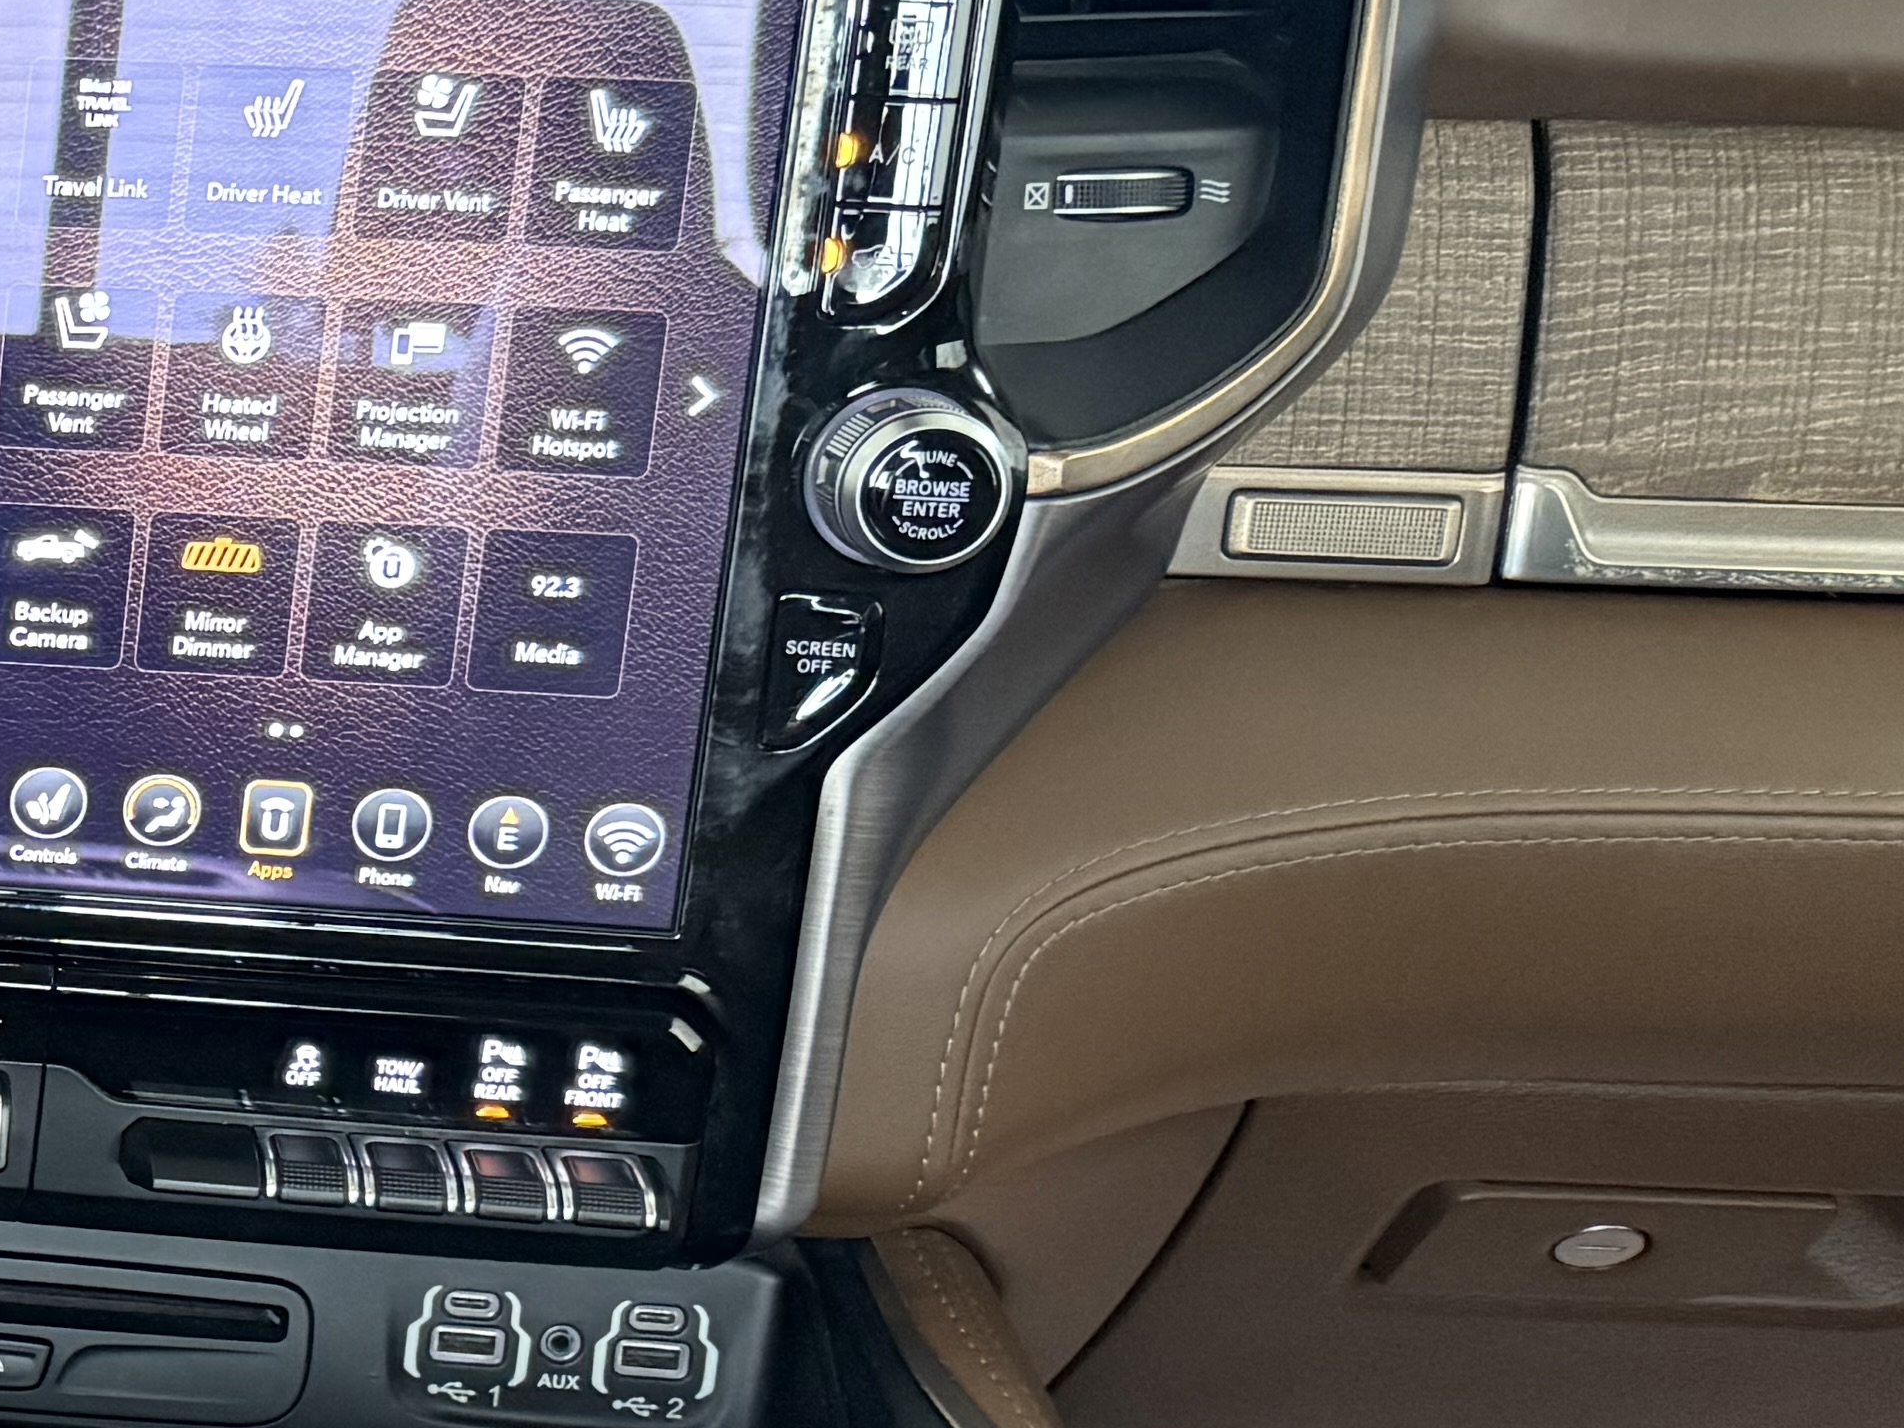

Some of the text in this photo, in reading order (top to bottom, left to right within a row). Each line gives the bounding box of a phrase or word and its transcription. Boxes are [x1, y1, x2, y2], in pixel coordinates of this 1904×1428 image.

[868, 142, 917, 165] A/C
[42, 174, 149, 200] Travel Link
[206, 181, 323, 206] Driver Heat
[554, 181, 664, 208] Passenger
[377, 186, 493, 213] Driver Vent
[578, 210, 632, 233] Heat
[23, 384, 125, 410] Passenger
[202, 393, 278, 416] Heated
[47, 411, 95, 435] Vent
[356, 400, 459, 426] Projection
[550, 408, 608, 432] Wi-Fi
[204, 418, 270, 443] Wheel
[360, 427, 452, 453] Manager
[532, 435, 618, 462] Hotspot
[894, 478, 971, 498] BROWSE
[901, 500, 961, 518] ENTER
[898, 521, 957, 541] SCROLL
[530, 575, 583, 598] 92.3
[14, 601, 89, 628] Backup
[184, 611, 247, 633] Mirror
[9, 626, 89, 651] Camera
[357, 621, 405, 645] App
[172, 636, 254, 660] Dimmer
[334, 645, 426, 671] Manager
[514, 642, 583, 666] Media
[785, 640, 856, 659] SCREEN
[796, 658, 833, 674] OFF
[496, 826, 520, 852] E
[9, 844, 78, 866] Controls
[124, 851, 188, 872] Climate
[248, 859, 293, 881] Apps
[358, 867, 414, 888] Phone
[484, 876, 521, 895] Nav
[595, 882, 643, 903] Wi-Fi
[284, 1070, 322, 1087] OFF
[375, 1058, 425, 1078] TOW/
[481, 1066, 520, 1083] OFF
[373, 1076, 422, 1095] HAUL
[473, 1083, 522, 1102] REAR
[577, 1073, 617, 1090] OFF
[564, 1090, 625, 1108] FRONT
[537, 1373, 581, 1391] AUX
[488, 1385, 501, 1407] 1
[665, 1397, 686, 1420] 2
